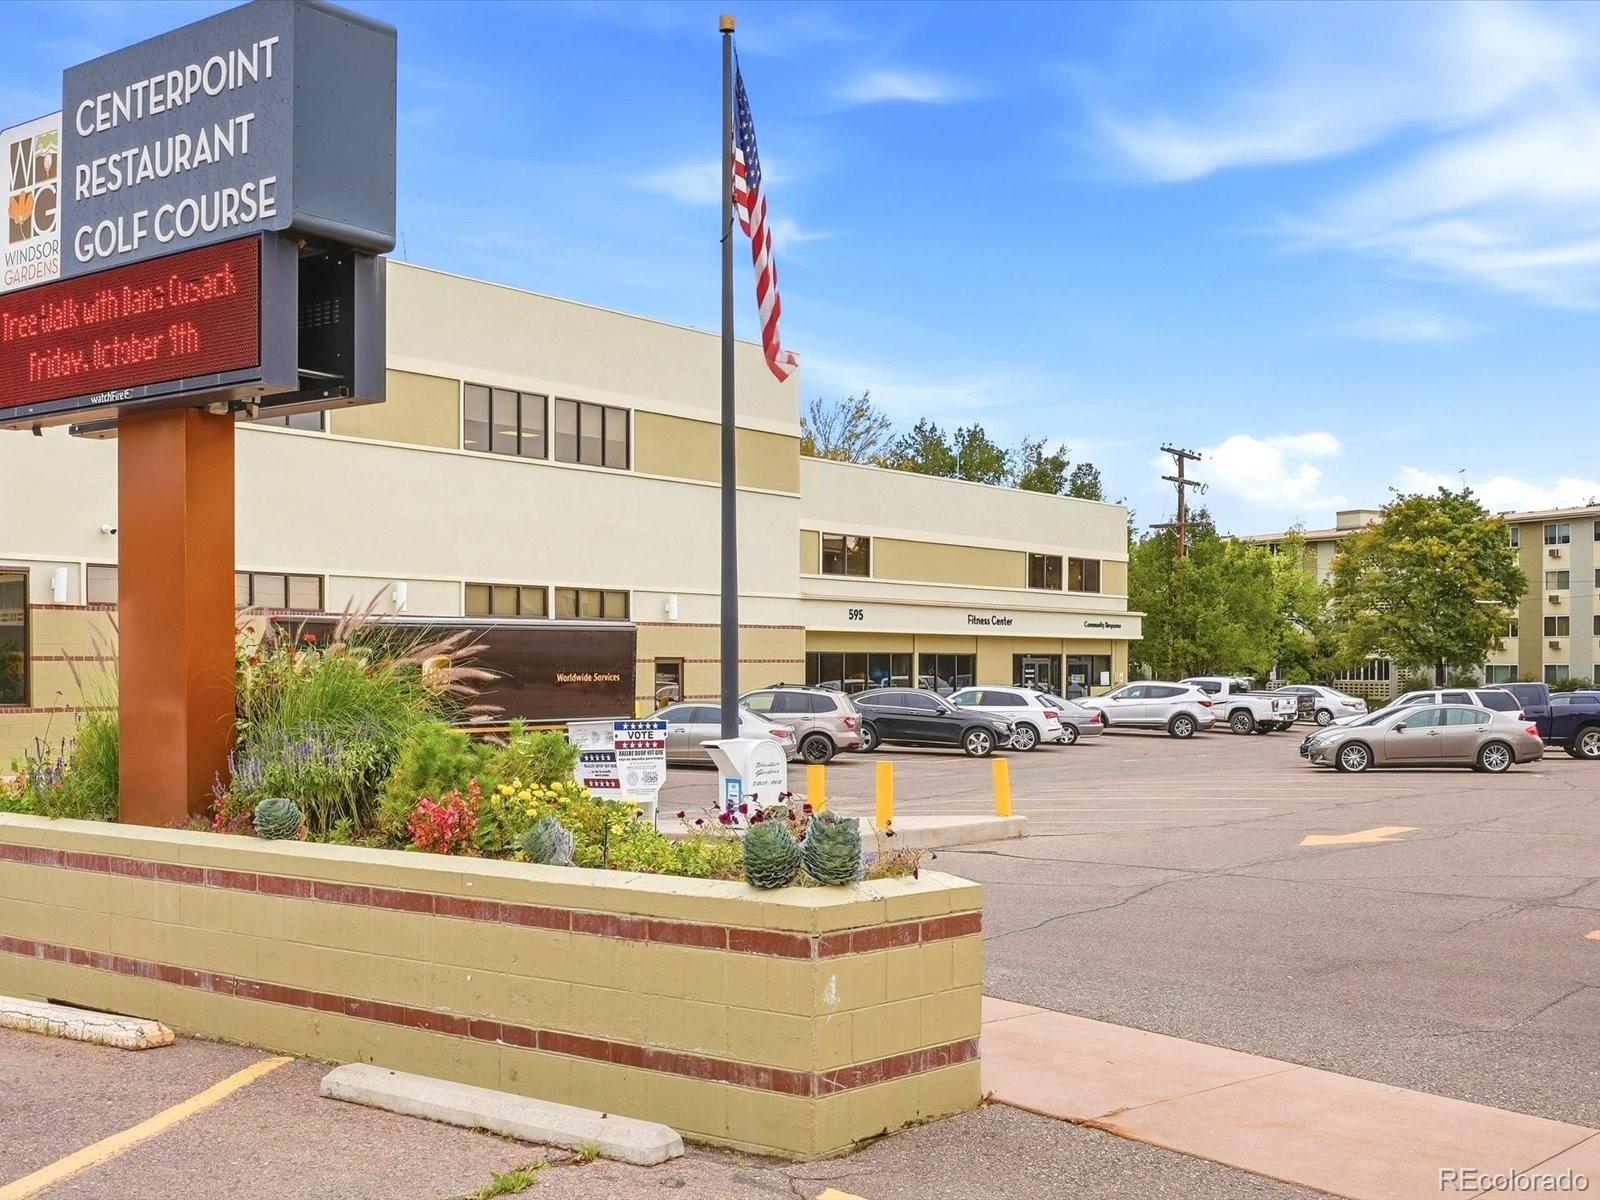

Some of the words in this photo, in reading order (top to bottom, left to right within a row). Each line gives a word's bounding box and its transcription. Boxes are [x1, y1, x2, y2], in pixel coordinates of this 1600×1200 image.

[76, 36, 279, 136] CENTERPOINT
[75, 113, 255, 200] RESTAURANT
[75, 210, 149, 262] GOLF
[154, 176, 277, 242] COURSE
[4, 239, 59, 266] WINDSOR
[4, 260, 59, 286] GARDENS
[3, 313, 37, 341] Tree
[41, 298, 79, 333] Walk
[83, 289, 119, 324] with
[93, 333, 164, 370] October
[169, 322, 199, 356] 9th
[848, 608, 864, 621] 595
[967, 614, 989, 627] Fitness
[991, 616, 1013, 627] Center
[556, 673, 593, 682] Worldwide
[593, 673, 620, 682] Services
[627, 731, 654, 740] VOTE
